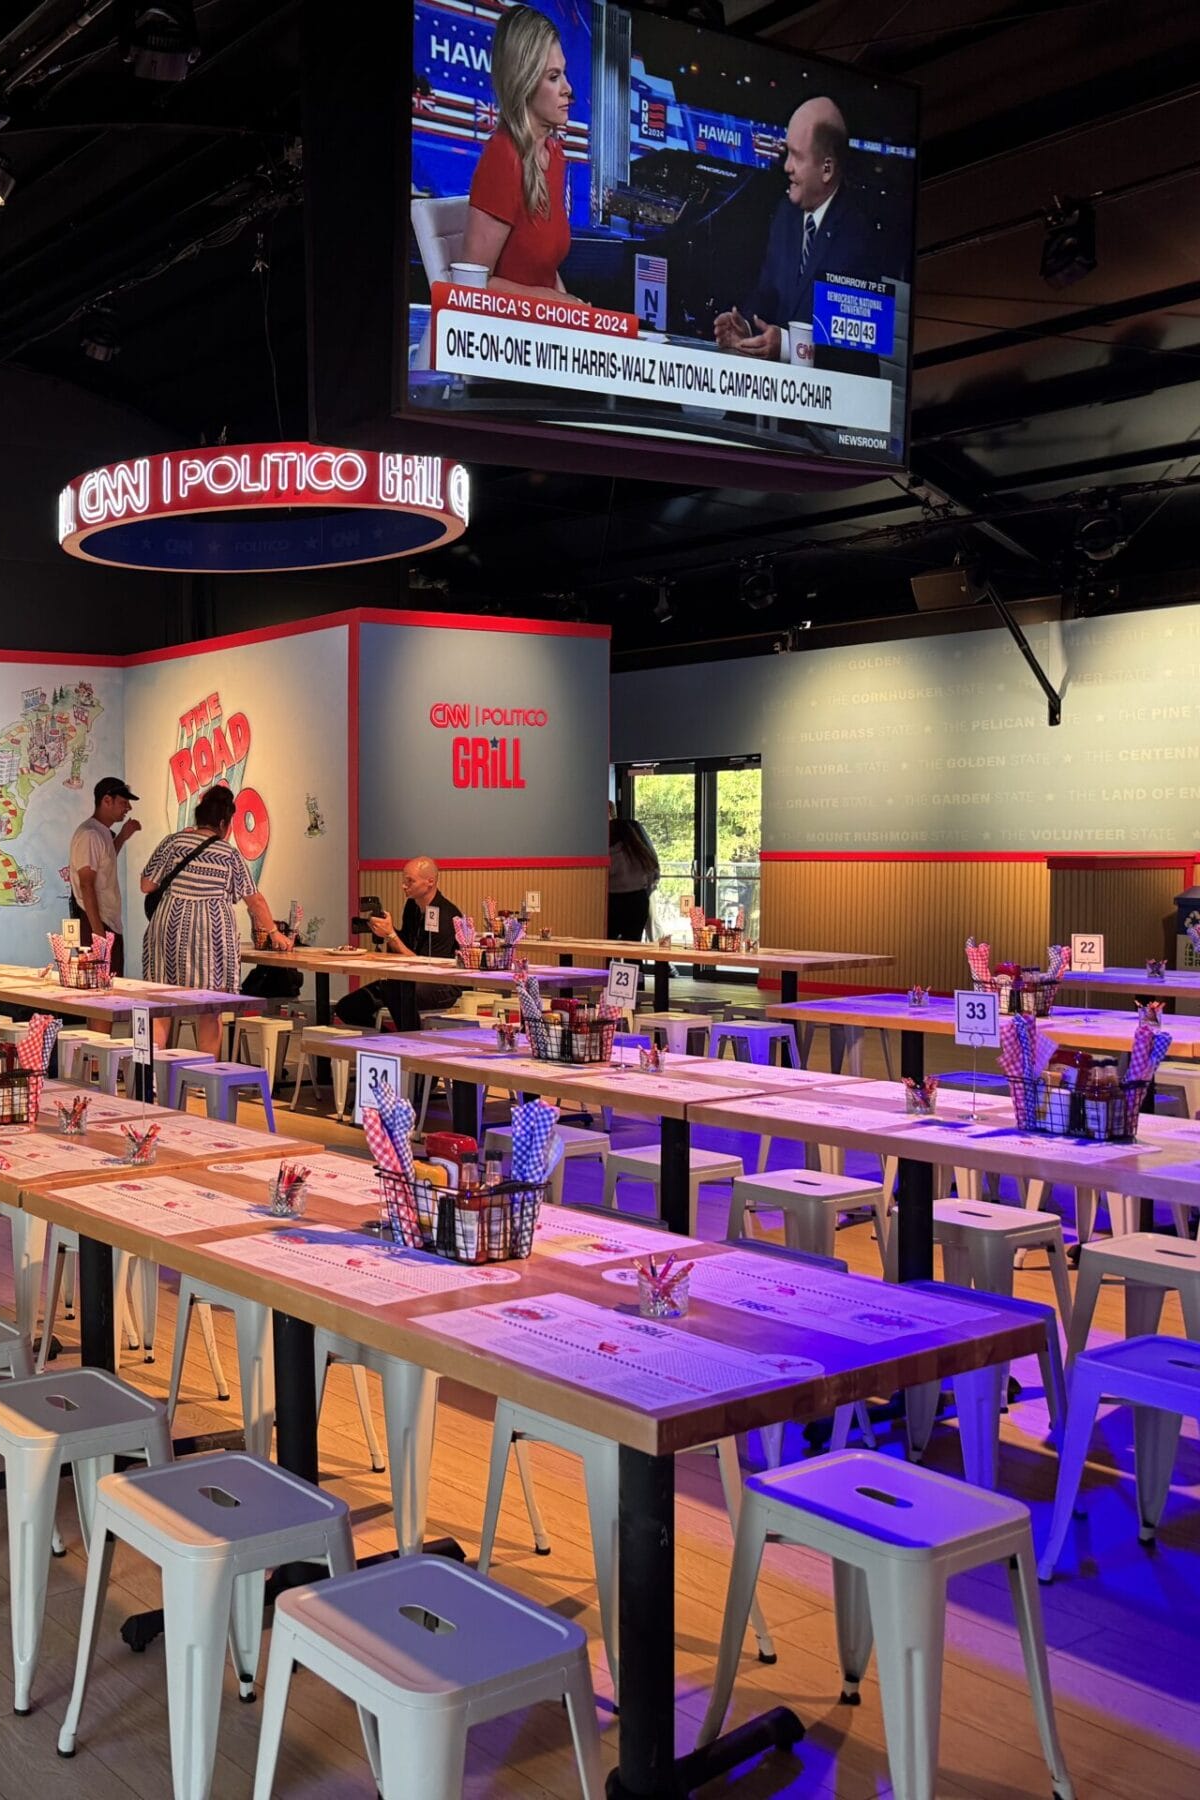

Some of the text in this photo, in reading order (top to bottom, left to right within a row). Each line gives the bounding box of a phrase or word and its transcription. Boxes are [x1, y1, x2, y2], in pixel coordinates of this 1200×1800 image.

[430, 34, 492, 73] HAW
[698, 123, 741, 147] HAWAII
[825, 272, 868, 289] TOMORROW
[877, 283, 887, 293] ET
[447, 288, 629, 334] AMERICA'S CHOICE 2024
[833, 319, 875, 341] 24 20 43
[446, 327, 833, 410] ONE-ON-ONE WITH HARRIS-WALZ NATIONAL CAMPAIGN CO-CHAIR
[838, 434, 887, 450] NEWSROOM
[79, 459, 150, 523] CNN
[179, 452, 368, 498] POLITICO
[847, 655, 901, 671] GOLDEN
[851, 686, 943, 705] CORNHUSKER
[179, 692, 223, 738] THE
[430, 703, 548, 729] CNN POLITICO
[800, 727, 875, 743] BLUEGRASS
[971, 716, 1036, 732] PELICAN
[1151, 705, 1192, 721] PINE
[169, 712, 251, 805] ROAD
[795, 762, 850, 777] NATURAL
[946, 755, 1006, 769] GOLDEN
[1011, 752, 1051, 766] STATE
[1087, 750, 1113, 763] THE
[786, 796, 840, 809] GRANITE
[932, 791, 990, 806] GARDEN
[1069, 789, 1097, 802] THE
[1101, 787, 1147, 801] LAND
[1151, 787, 1177, 801] OF
[806, 831, 852, 843] MOUNT
[853, 830, 928, 843] RUSHMORE
[1001, 829, 1026, 842] THE
[1030, 828, 1126, 842] VOLUNTEER
[1130, 828, 1177, 841] STATE
[67, 924, 75, 934] 13
[1080, 941, 1096, 954] 22
[615, 971, 630, 987] 23
[965, 1001, 987, 1021] 33
[137, 1016, 146, 1036] 24
[368, 1066, 389, 1089] 34
